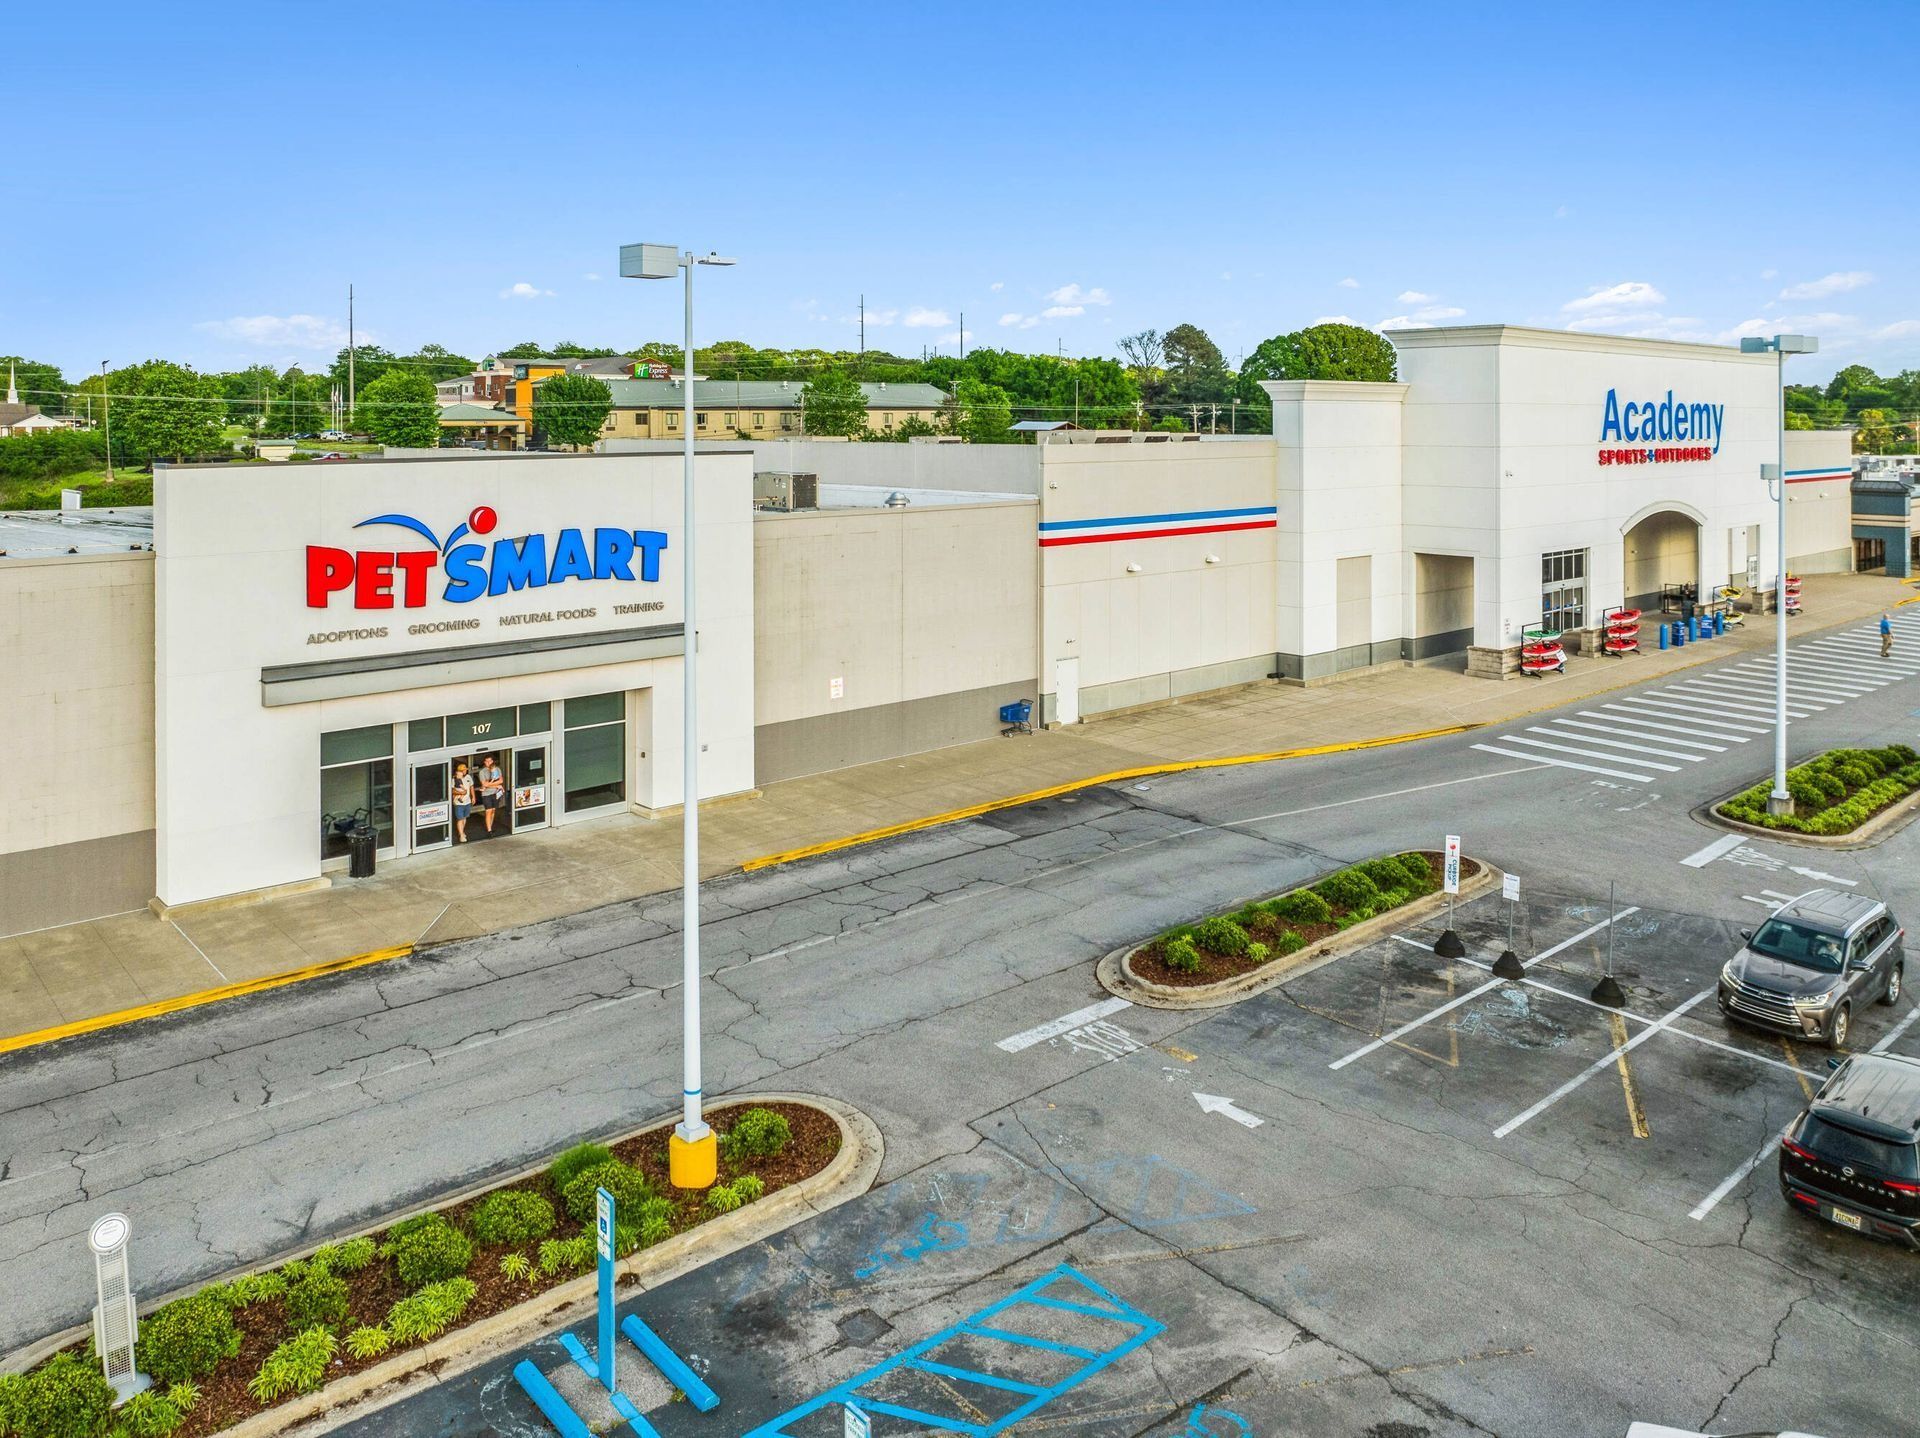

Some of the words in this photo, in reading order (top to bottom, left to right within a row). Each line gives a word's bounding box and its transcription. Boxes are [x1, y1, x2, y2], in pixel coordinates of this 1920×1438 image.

[1601, 388, 1724, 455] Academy
[307, 627, 389, 645] ADOPTIONS
[408, 618, 481, 636] GROOMING
[500, 611, 554, 626] NATURAL
[557, 607, 598, 621] FOODS
[613, 601, 665, 615] TRAINING
[472, 723, 491, 735] 107
